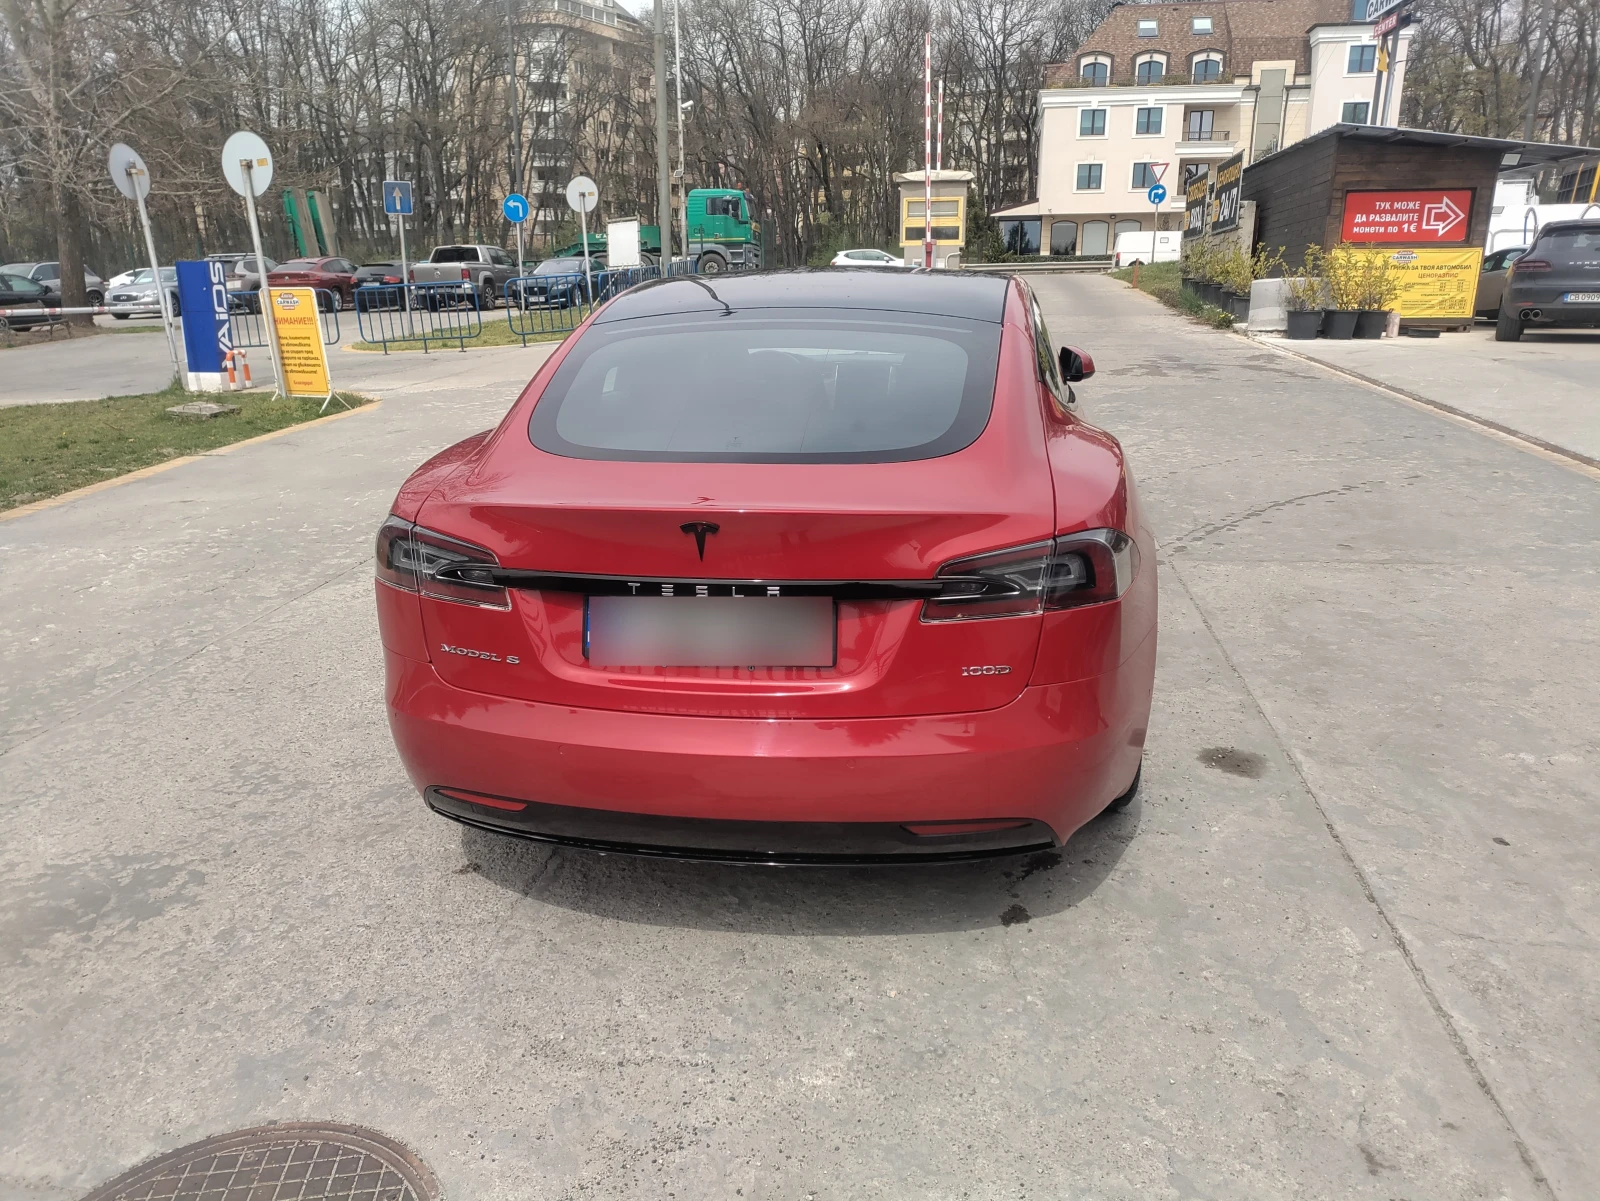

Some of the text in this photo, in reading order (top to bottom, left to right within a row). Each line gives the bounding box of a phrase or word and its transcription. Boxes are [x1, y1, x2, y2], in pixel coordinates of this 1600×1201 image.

[1374, 15, 1397, 36] CENTER
[1219, 187, 1238, 221] 24/7
[1375, 201, 1420, 210] ТУК МОЖЕ
[1354, 213, 1419, 223] ДА РАЗВАЛИТЕ
[1401, 223, 1418, 233] 1€
[275, 316, 314, 325] НИМАНИЕ!!!
[627, 582, 780, 598] TESLA
[440, 643, 520, 664] MODEL S
[961, 665, 1013, 676] 100D
